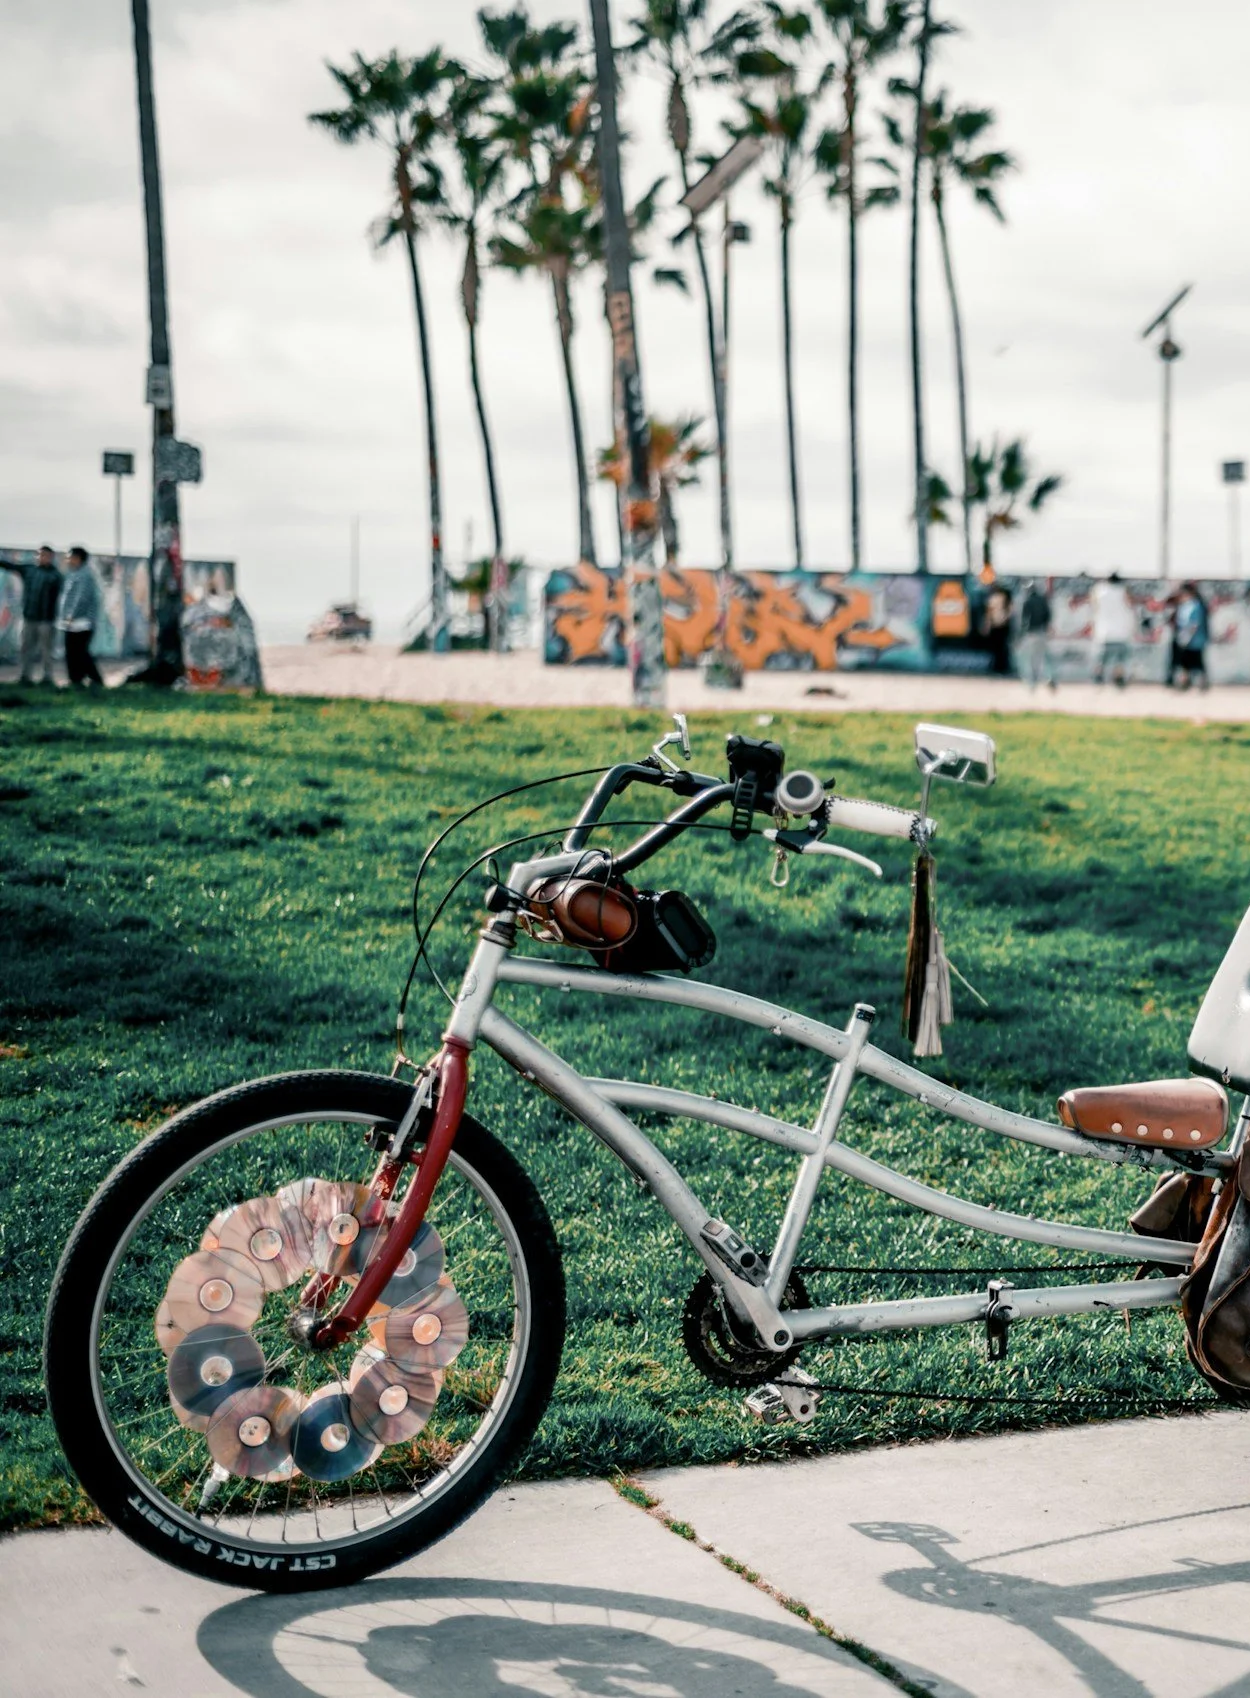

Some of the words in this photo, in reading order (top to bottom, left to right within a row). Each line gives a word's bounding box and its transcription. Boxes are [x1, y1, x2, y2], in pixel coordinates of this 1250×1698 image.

[127, 1495, 213, 1555] RABBIT
[215, 1546, 285, 1571] JACK
[288, 1554, 337, 1572] CST
